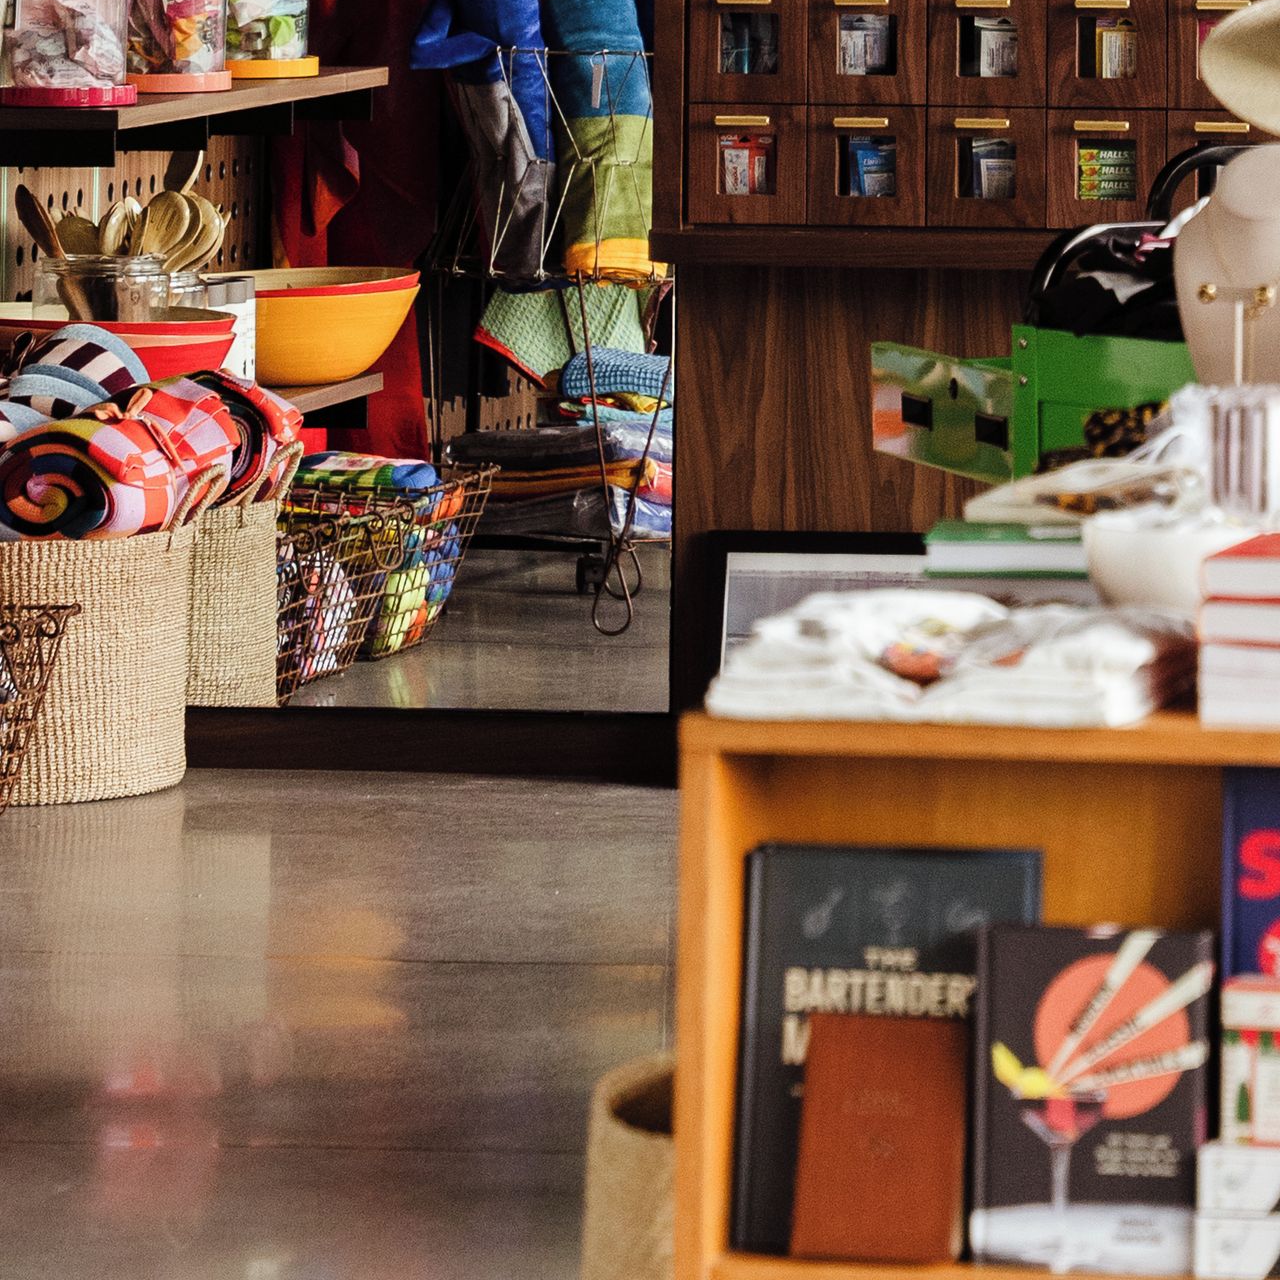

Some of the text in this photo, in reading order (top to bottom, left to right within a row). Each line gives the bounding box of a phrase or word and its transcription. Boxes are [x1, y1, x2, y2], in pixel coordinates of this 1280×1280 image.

[1100, 151, 1128, 159] HALLS
[1100, 166, 1130, 175] HALLS
[1100, 181, 1129, 189] HALLS
[863, 946, 918, 968] THE
